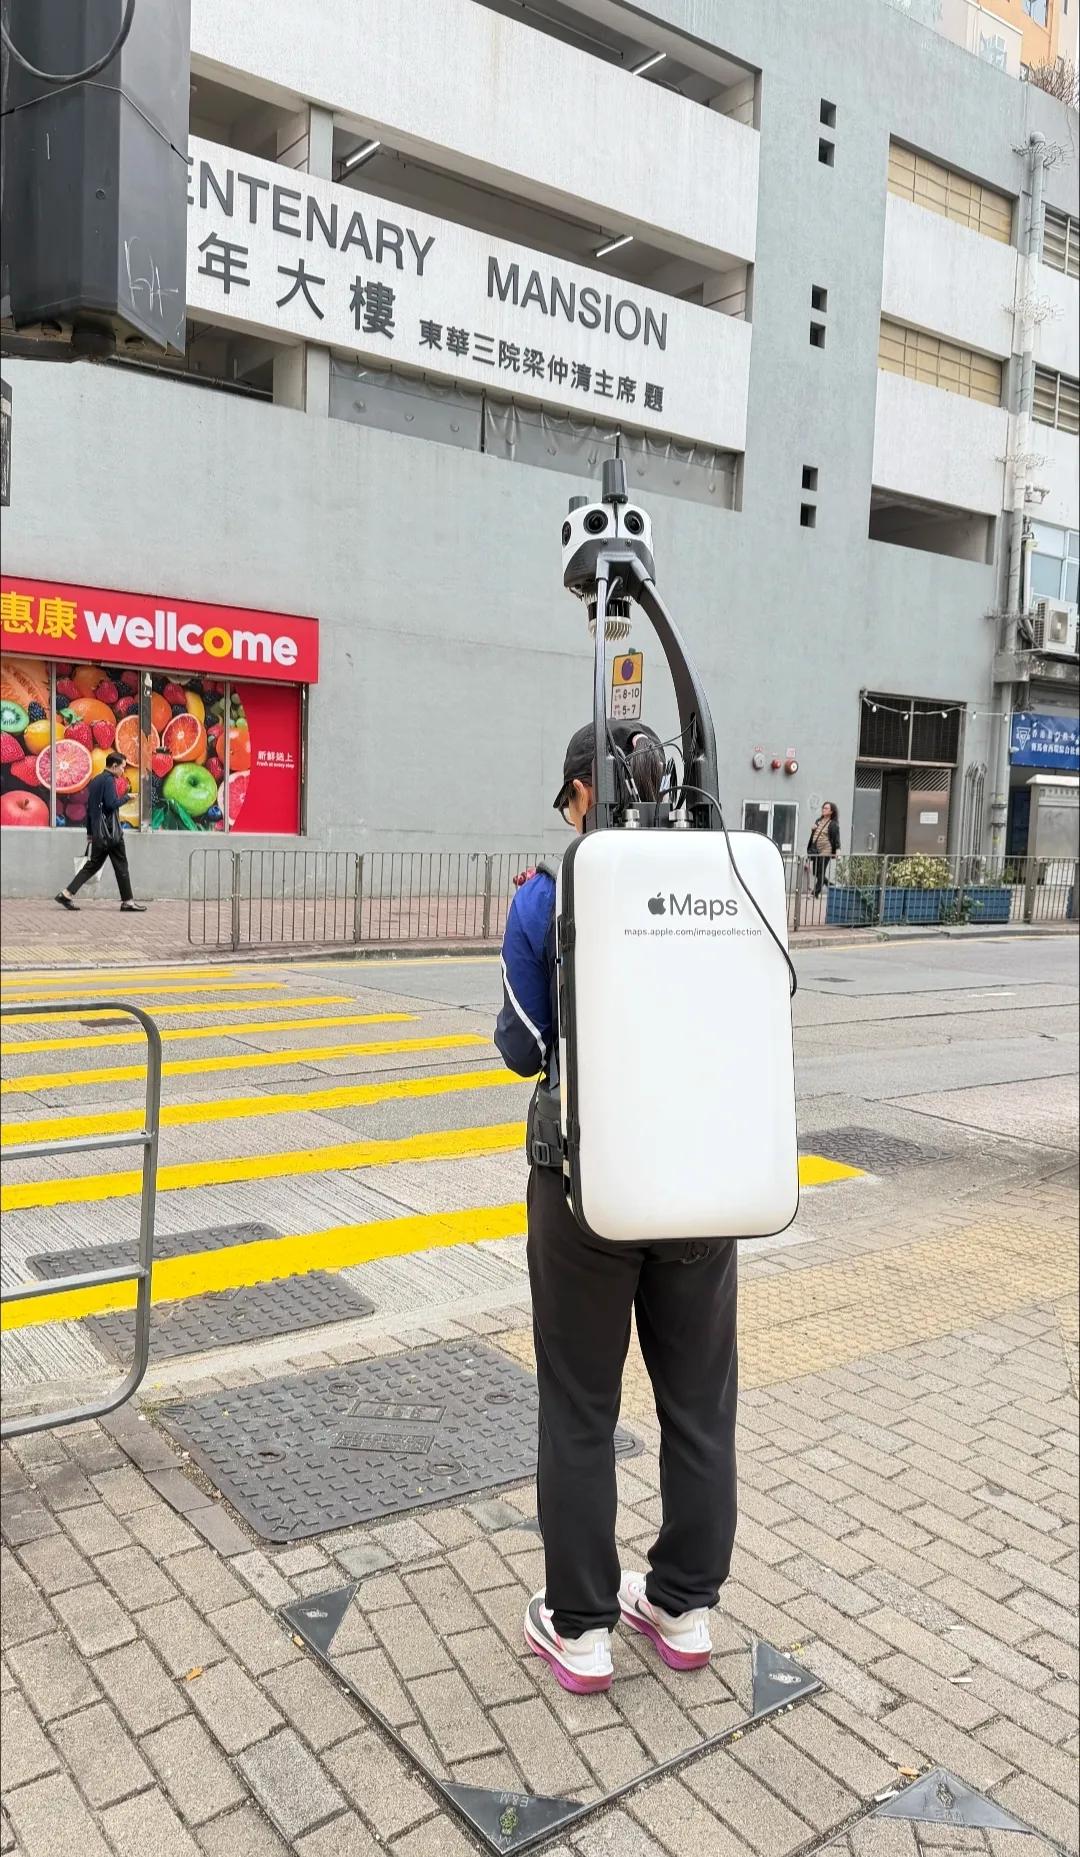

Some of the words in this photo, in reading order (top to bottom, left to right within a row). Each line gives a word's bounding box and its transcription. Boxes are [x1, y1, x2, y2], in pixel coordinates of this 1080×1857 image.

[187, 157, 435, 276] NTENARY
[487, 256, 668, 350] MANSION
[198, 231, 396, 340] 年大樓
[1, 591, 78, 640] 惠康
[84, 610, 298, 666] wellcome
[624, 928, 762, 937] maps.apple.com/imagecollection
[669, 893, 738, 920] Maps
